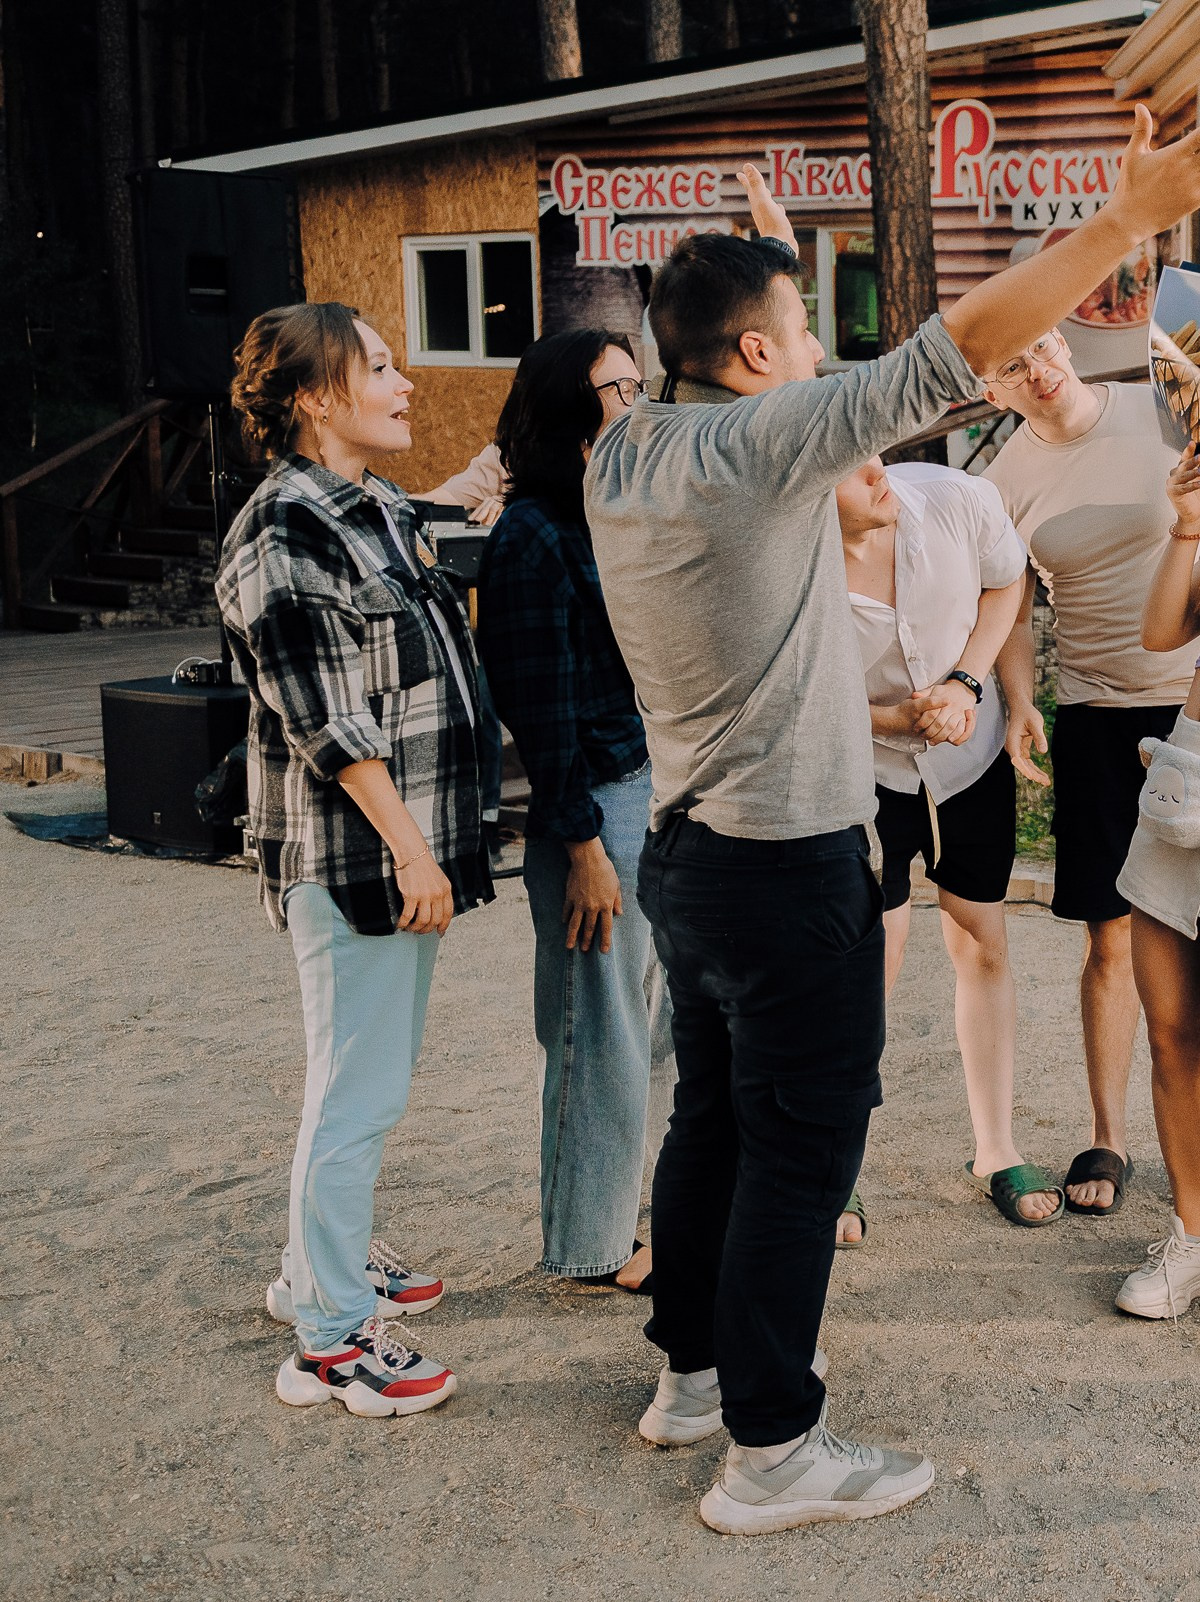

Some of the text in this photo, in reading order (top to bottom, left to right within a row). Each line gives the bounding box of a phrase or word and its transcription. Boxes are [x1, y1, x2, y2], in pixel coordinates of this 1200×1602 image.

[554, 159, 717, 210] Свежее
[933, 105, 1122, 218] Русска
[580, 215, 719, 263] Пенн
